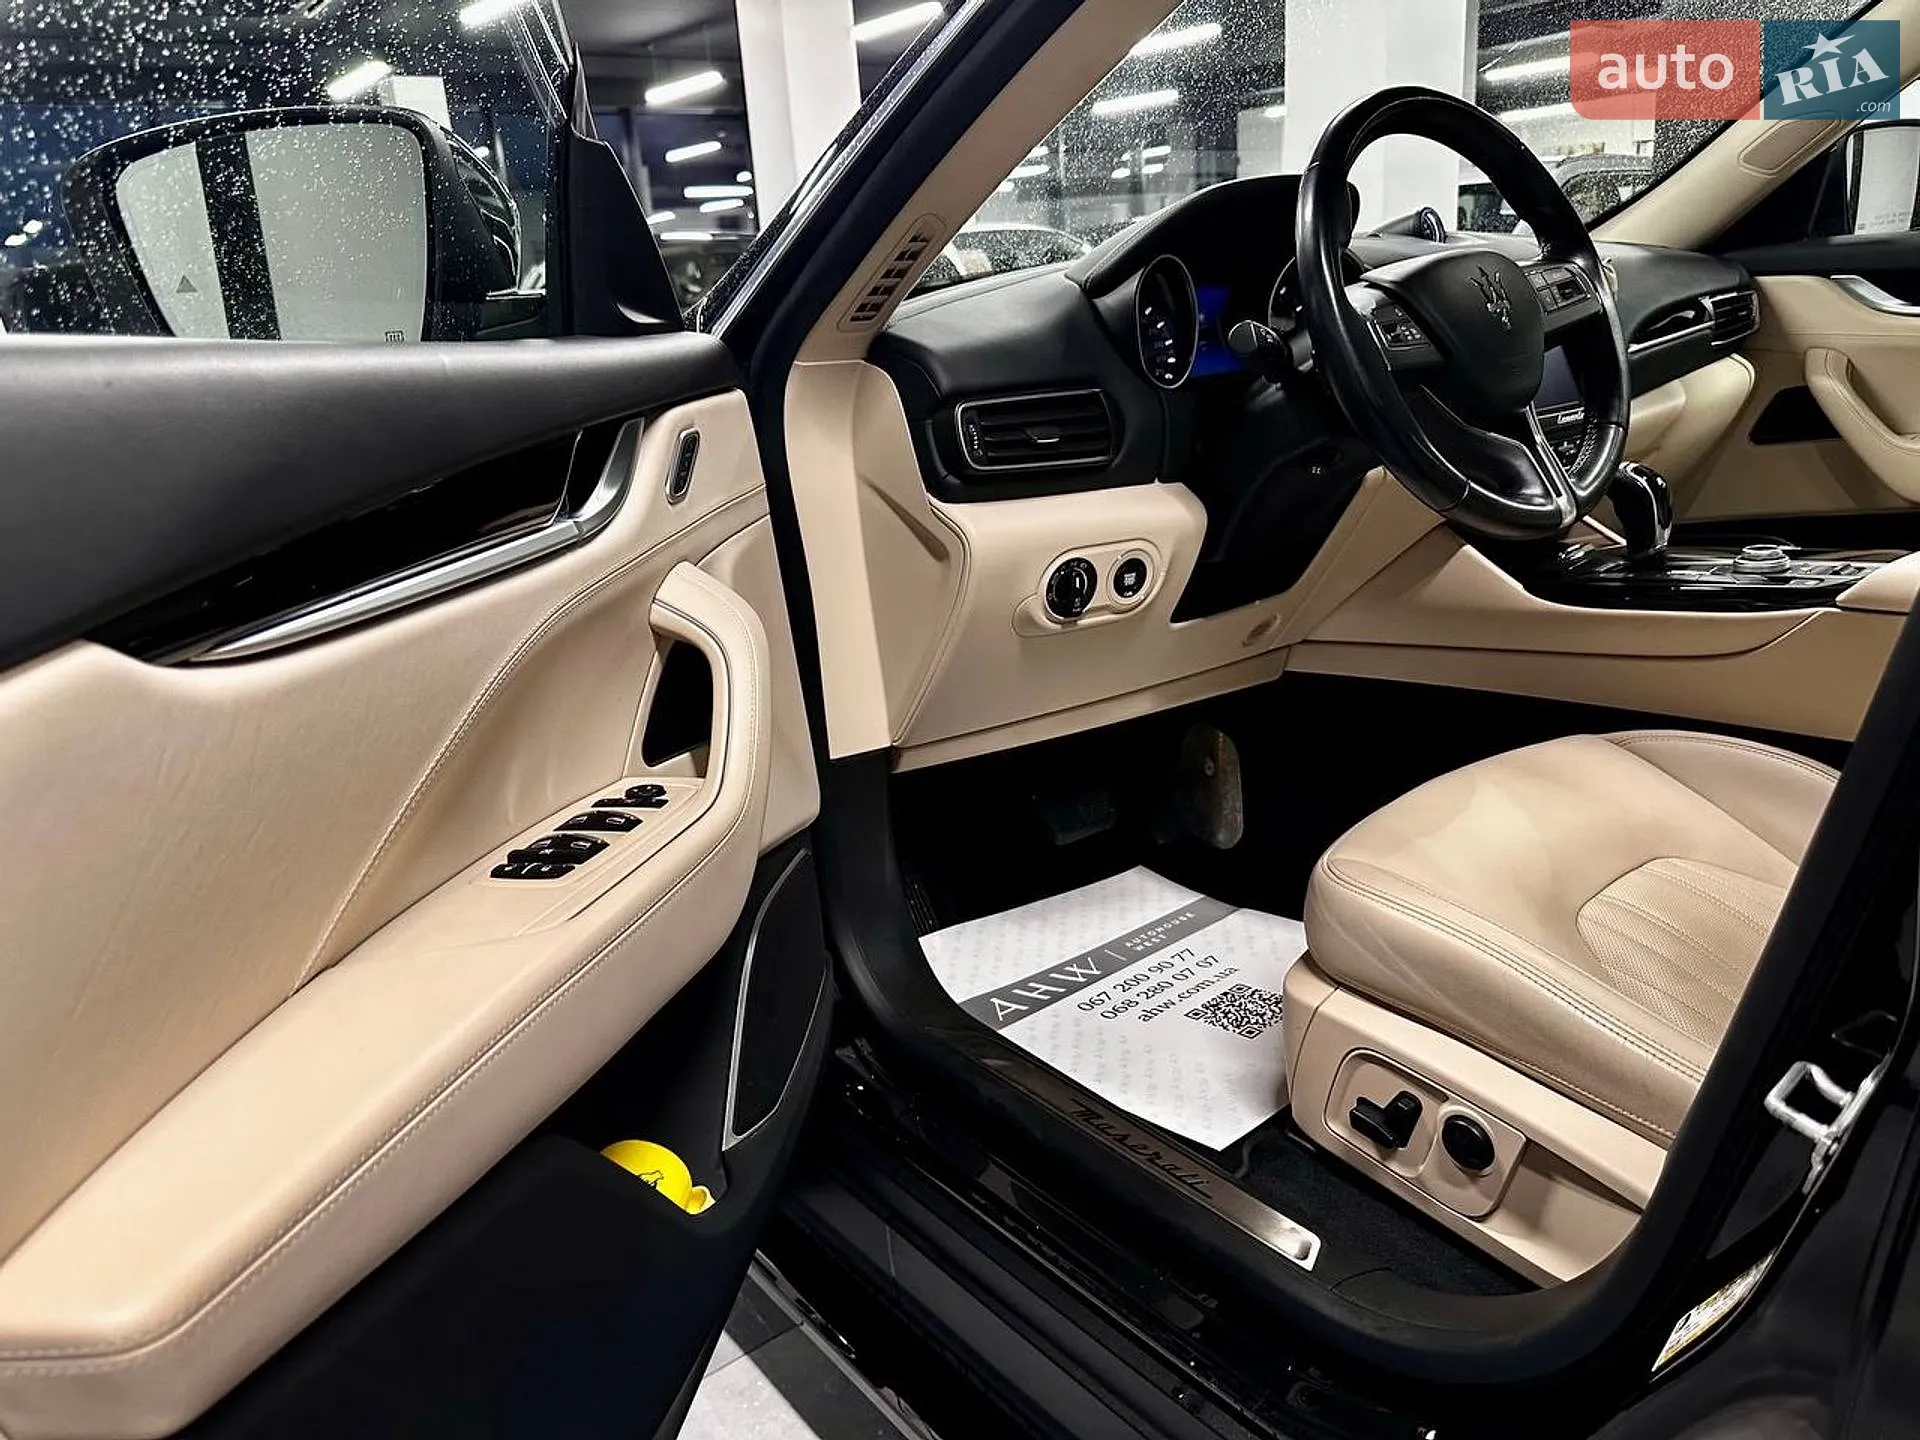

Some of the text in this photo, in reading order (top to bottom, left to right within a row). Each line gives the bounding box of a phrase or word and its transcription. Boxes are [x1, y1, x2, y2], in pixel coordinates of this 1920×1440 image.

[989, 956, 1102, 1021] AHW
[1077, 947, 1196, 1012] 067 200 90 77
[1100, 998, 1140, 1020] 068
[1171, 967, 1196, 981] 07
[1070, 1097, 1214, 1200] Maserati
